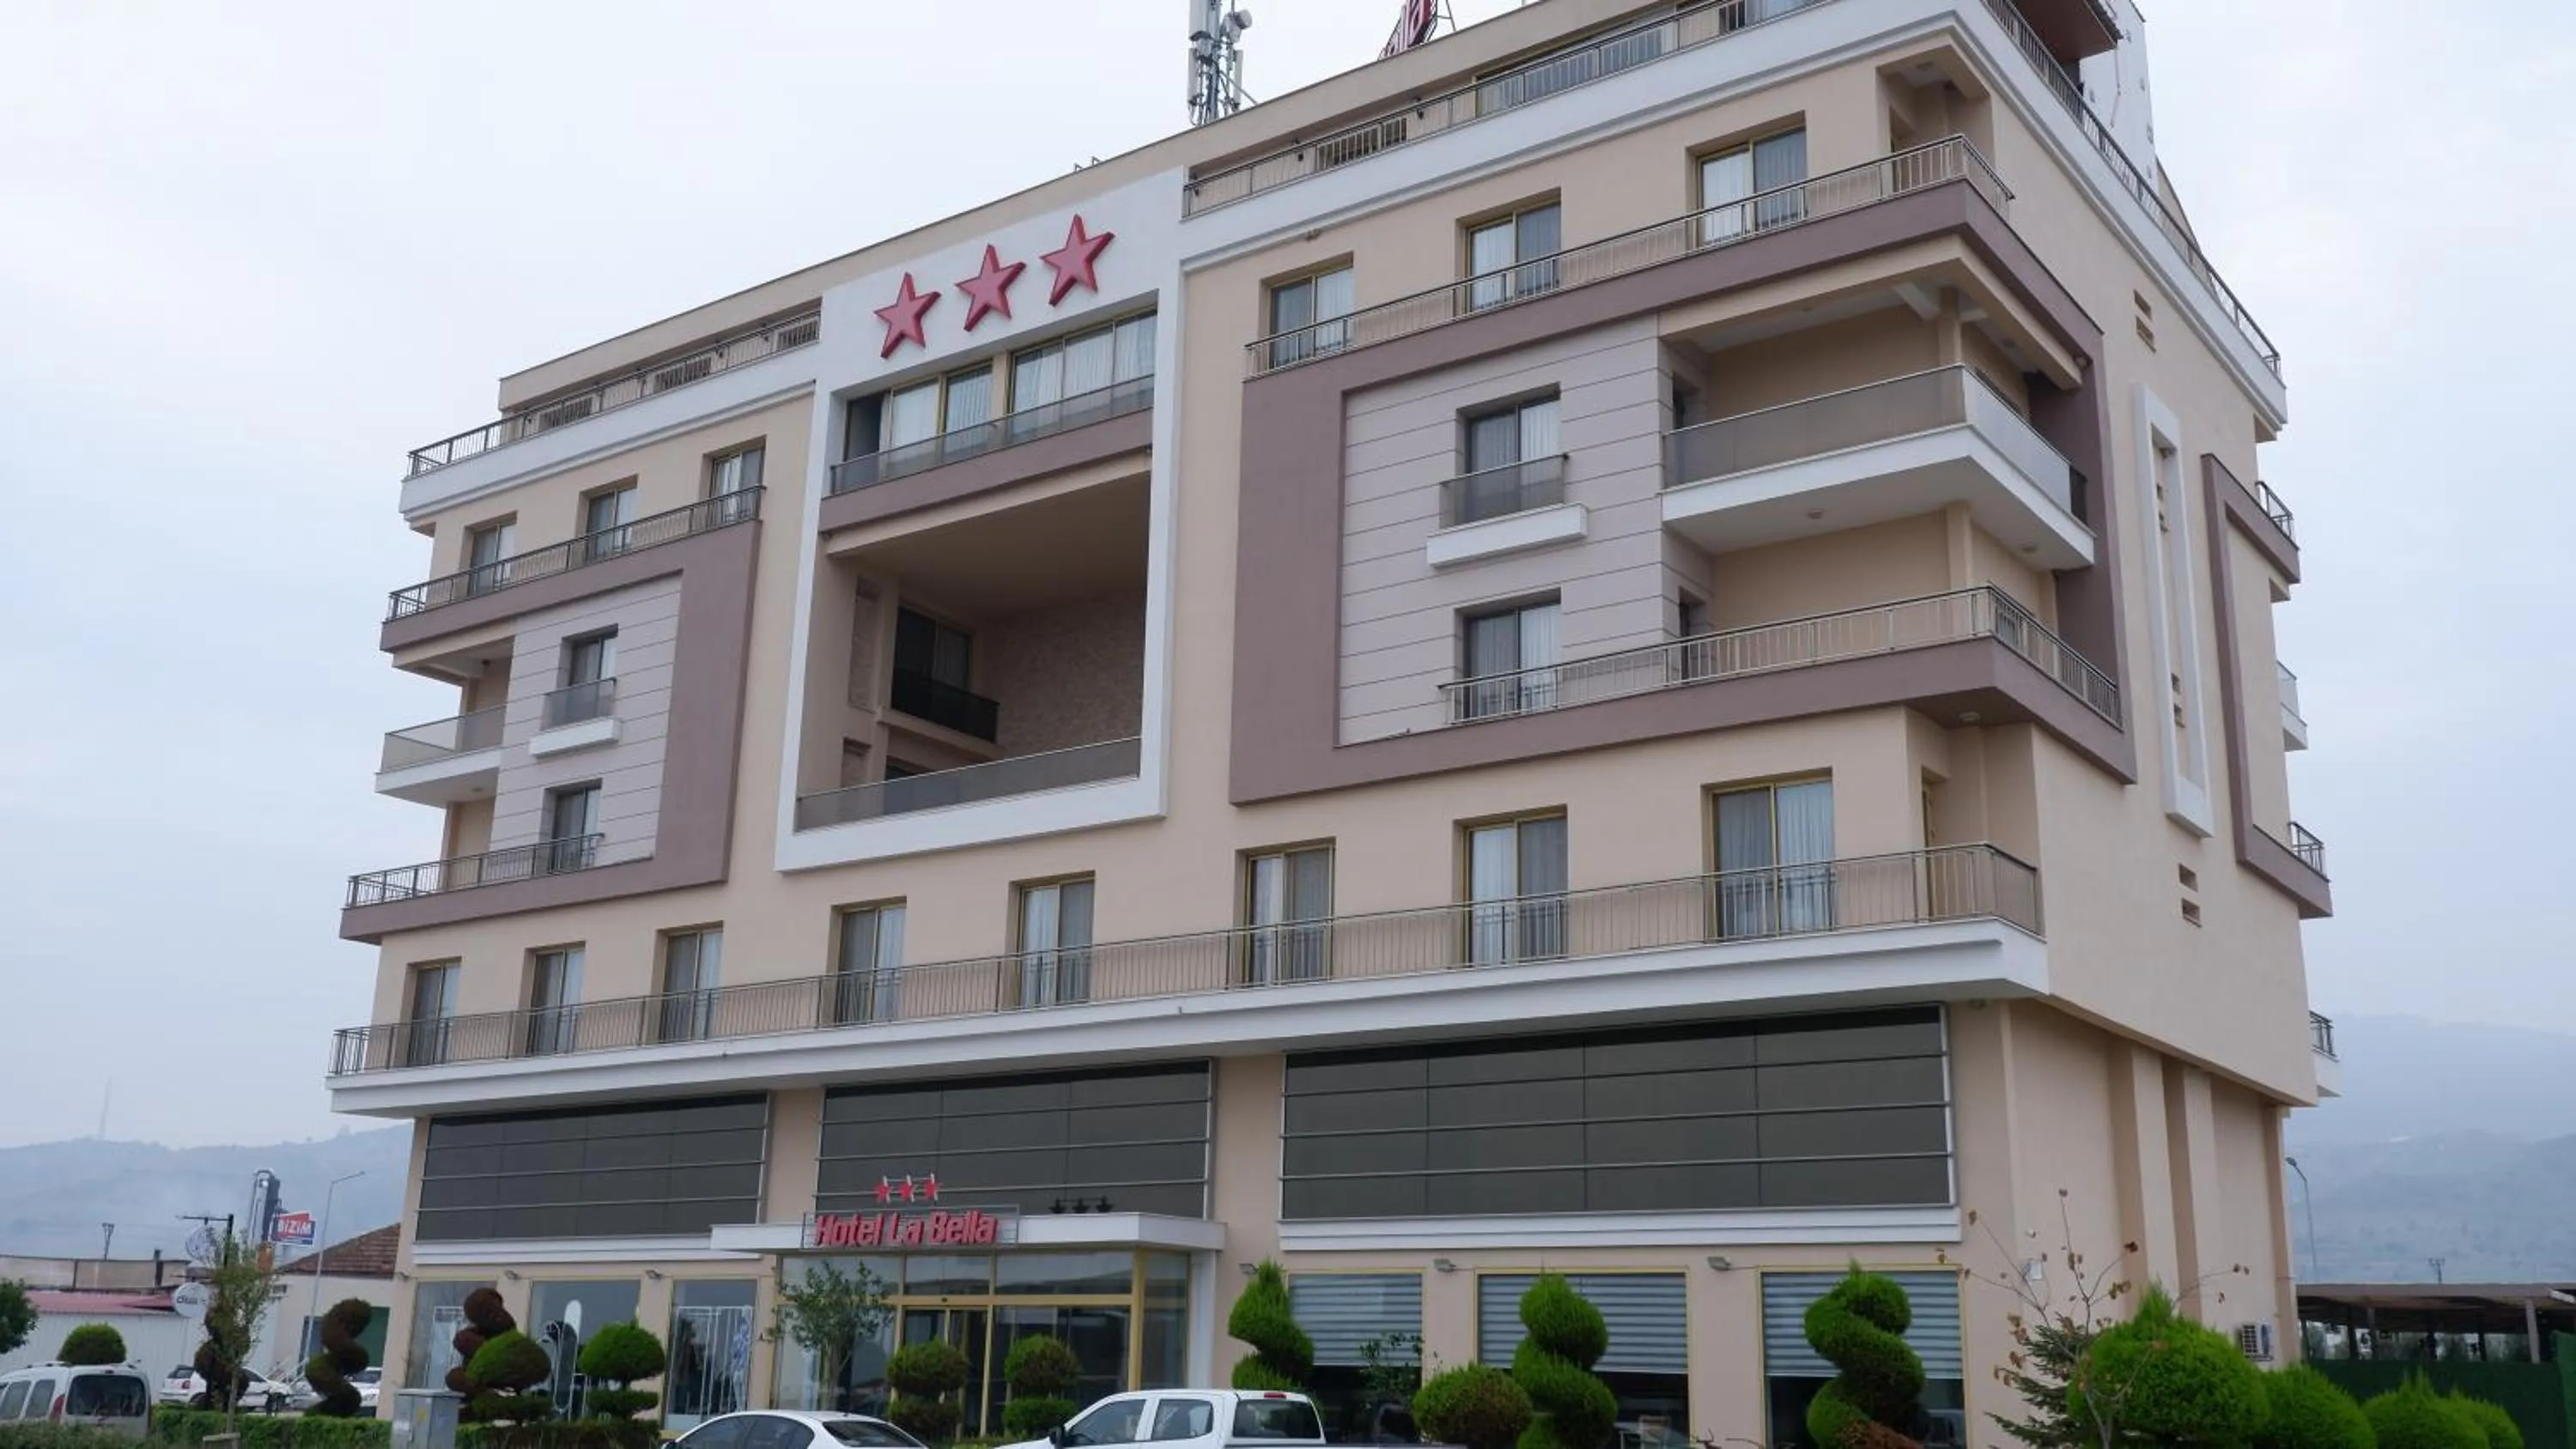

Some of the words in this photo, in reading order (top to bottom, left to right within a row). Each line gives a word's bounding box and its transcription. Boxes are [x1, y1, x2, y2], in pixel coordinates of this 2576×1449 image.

[816, 1211, 885, 1246] Hotel
[890, 1211, 925, 1246] La
[930, 1210, 998, 1245] Bella
